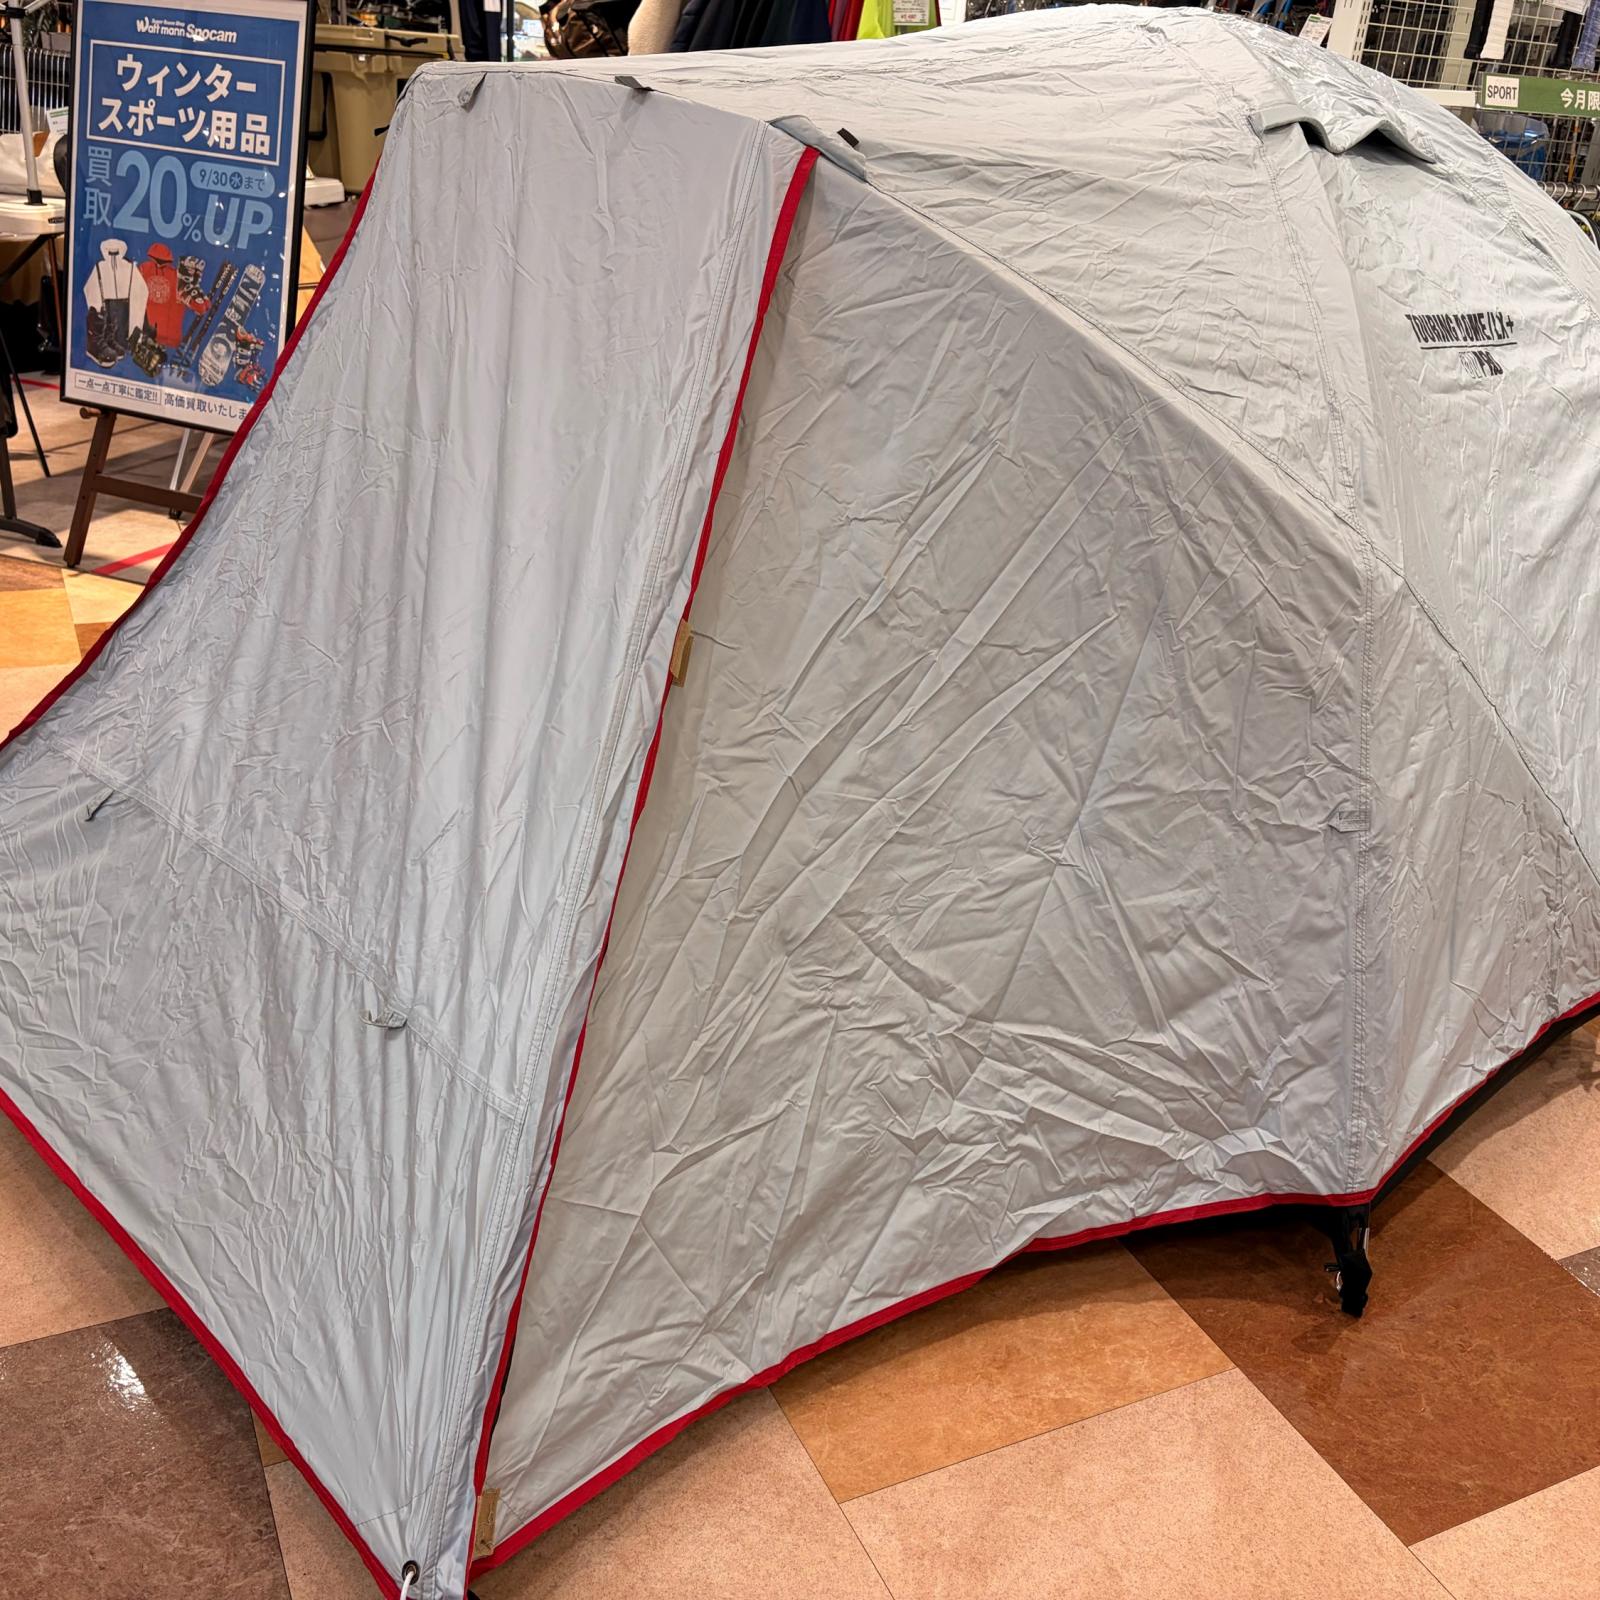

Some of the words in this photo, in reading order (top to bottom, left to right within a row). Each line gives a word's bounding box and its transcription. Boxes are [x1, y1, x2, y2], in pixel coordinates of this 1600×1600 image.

[117, 54, 256, 102] ウィンター
[1487, 84, 1517, 101] SPORT
[98, 97, 271, 156] スポーツ用品
[83, 145, 113, 227] 買取
[1405, 313, 1461, 343] TOURING
